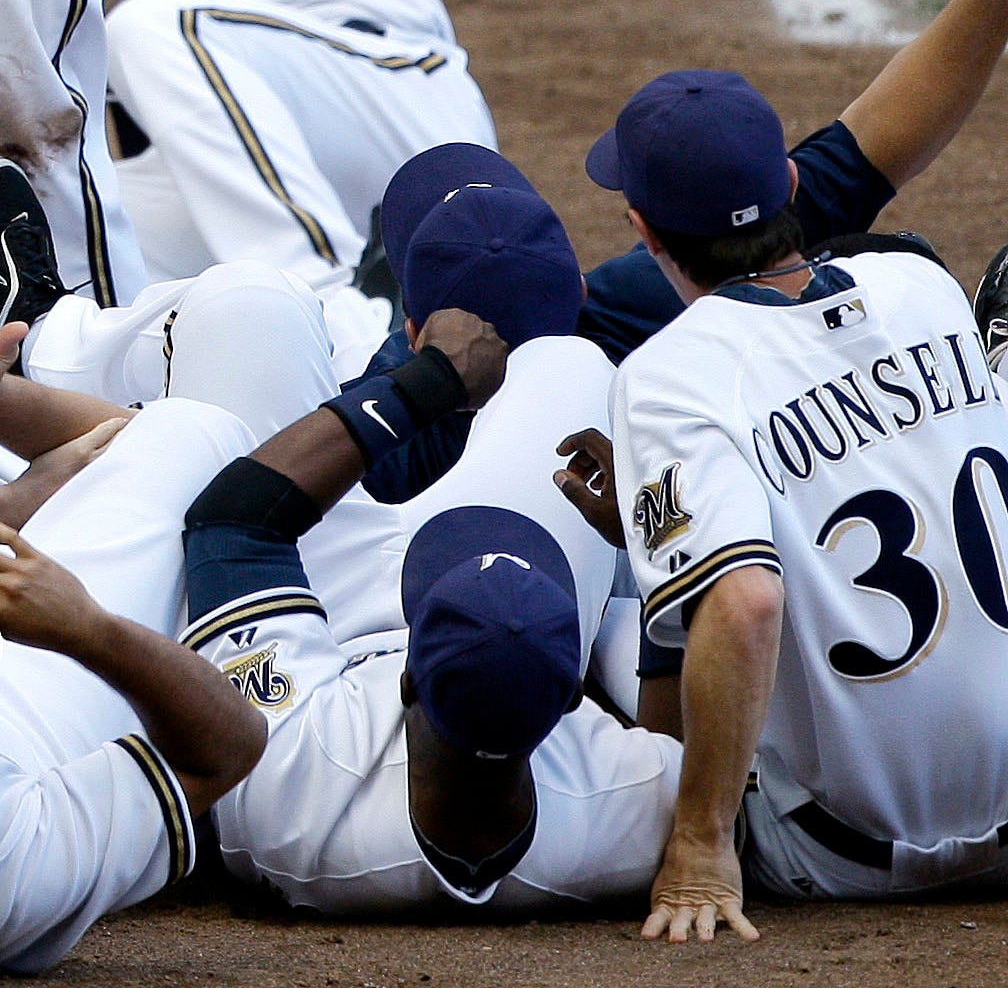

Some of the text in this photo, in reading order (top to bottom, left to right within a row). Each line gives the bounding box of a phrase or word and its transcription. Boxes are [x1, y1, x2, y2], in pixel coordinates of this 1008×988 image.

[753, 330, 1001, 497] COUNSEL
[634, 462, 687, 552] M
[815, 445, 1008, 684] 30
